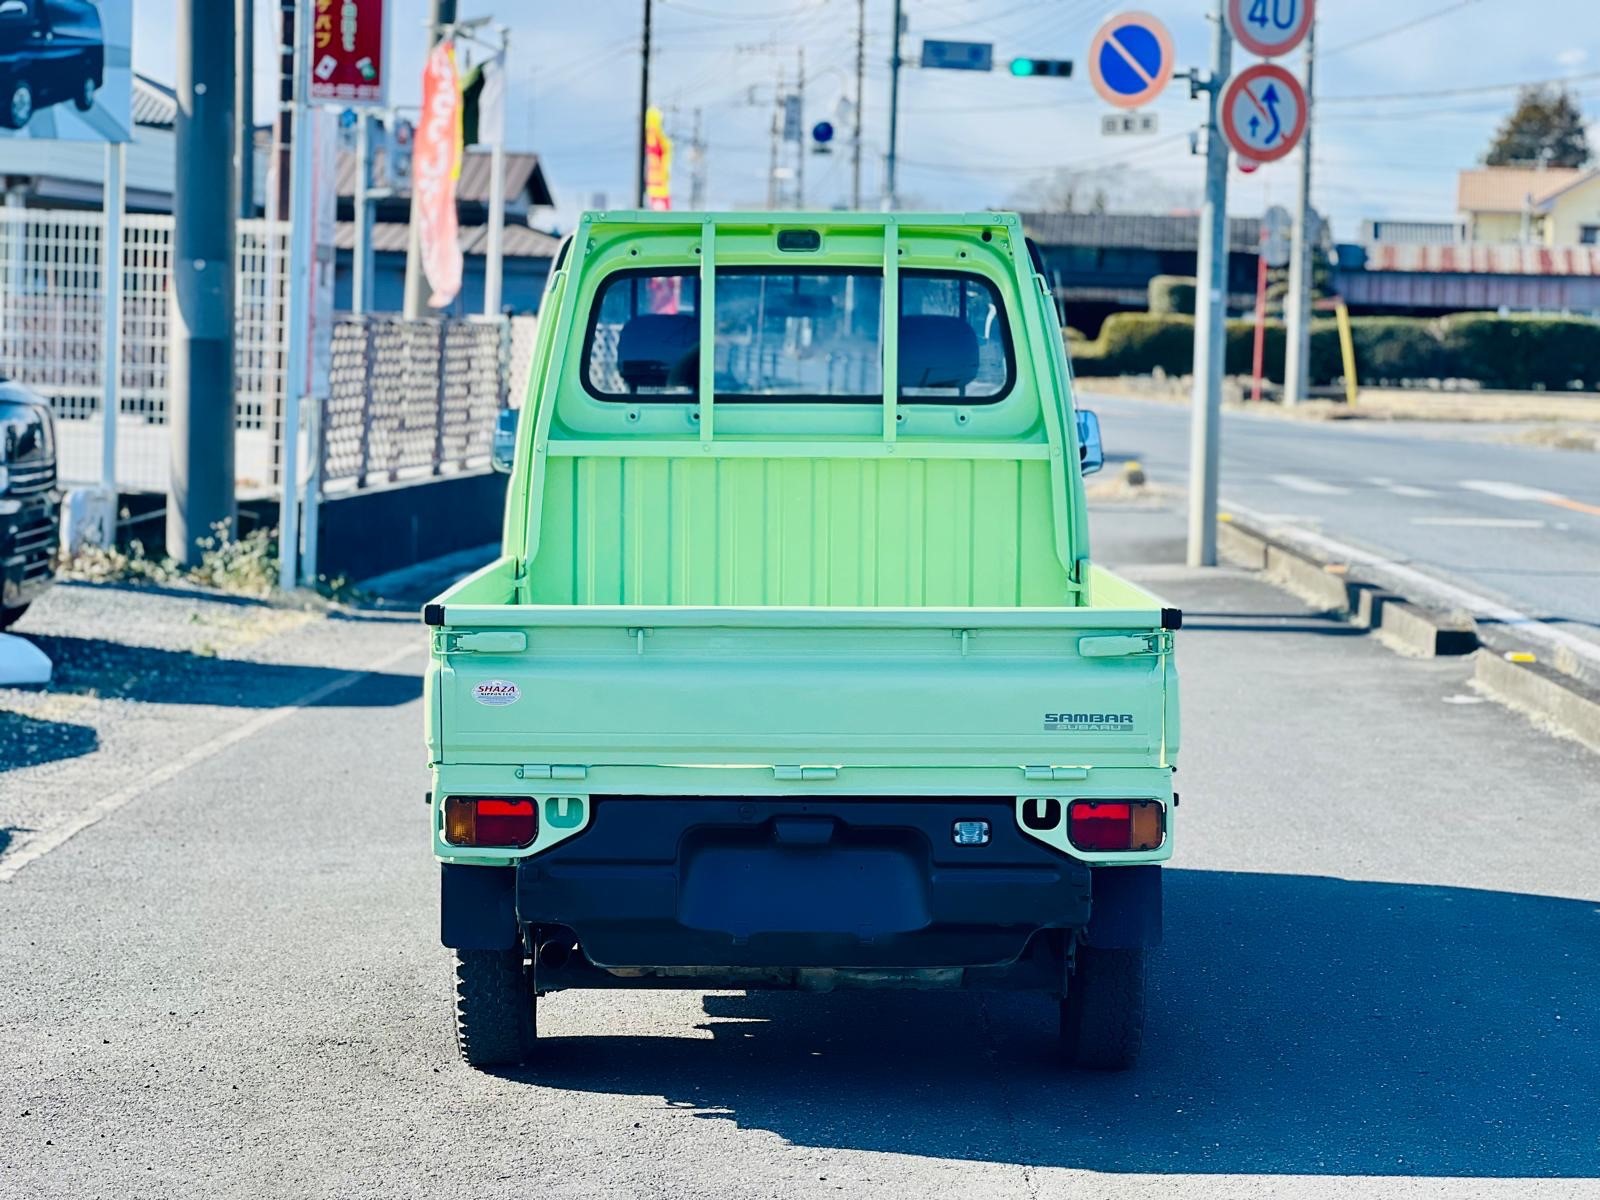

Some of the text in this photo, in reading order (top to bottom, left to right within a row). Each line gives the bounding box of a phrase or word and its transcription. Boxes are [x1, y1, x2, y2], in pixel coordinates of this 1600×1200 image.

[1248, 0, 1296, 30] 40
[478, 685, 515, 693] SHAZA
[1044, 713, 1134, 723] SAMBAR
